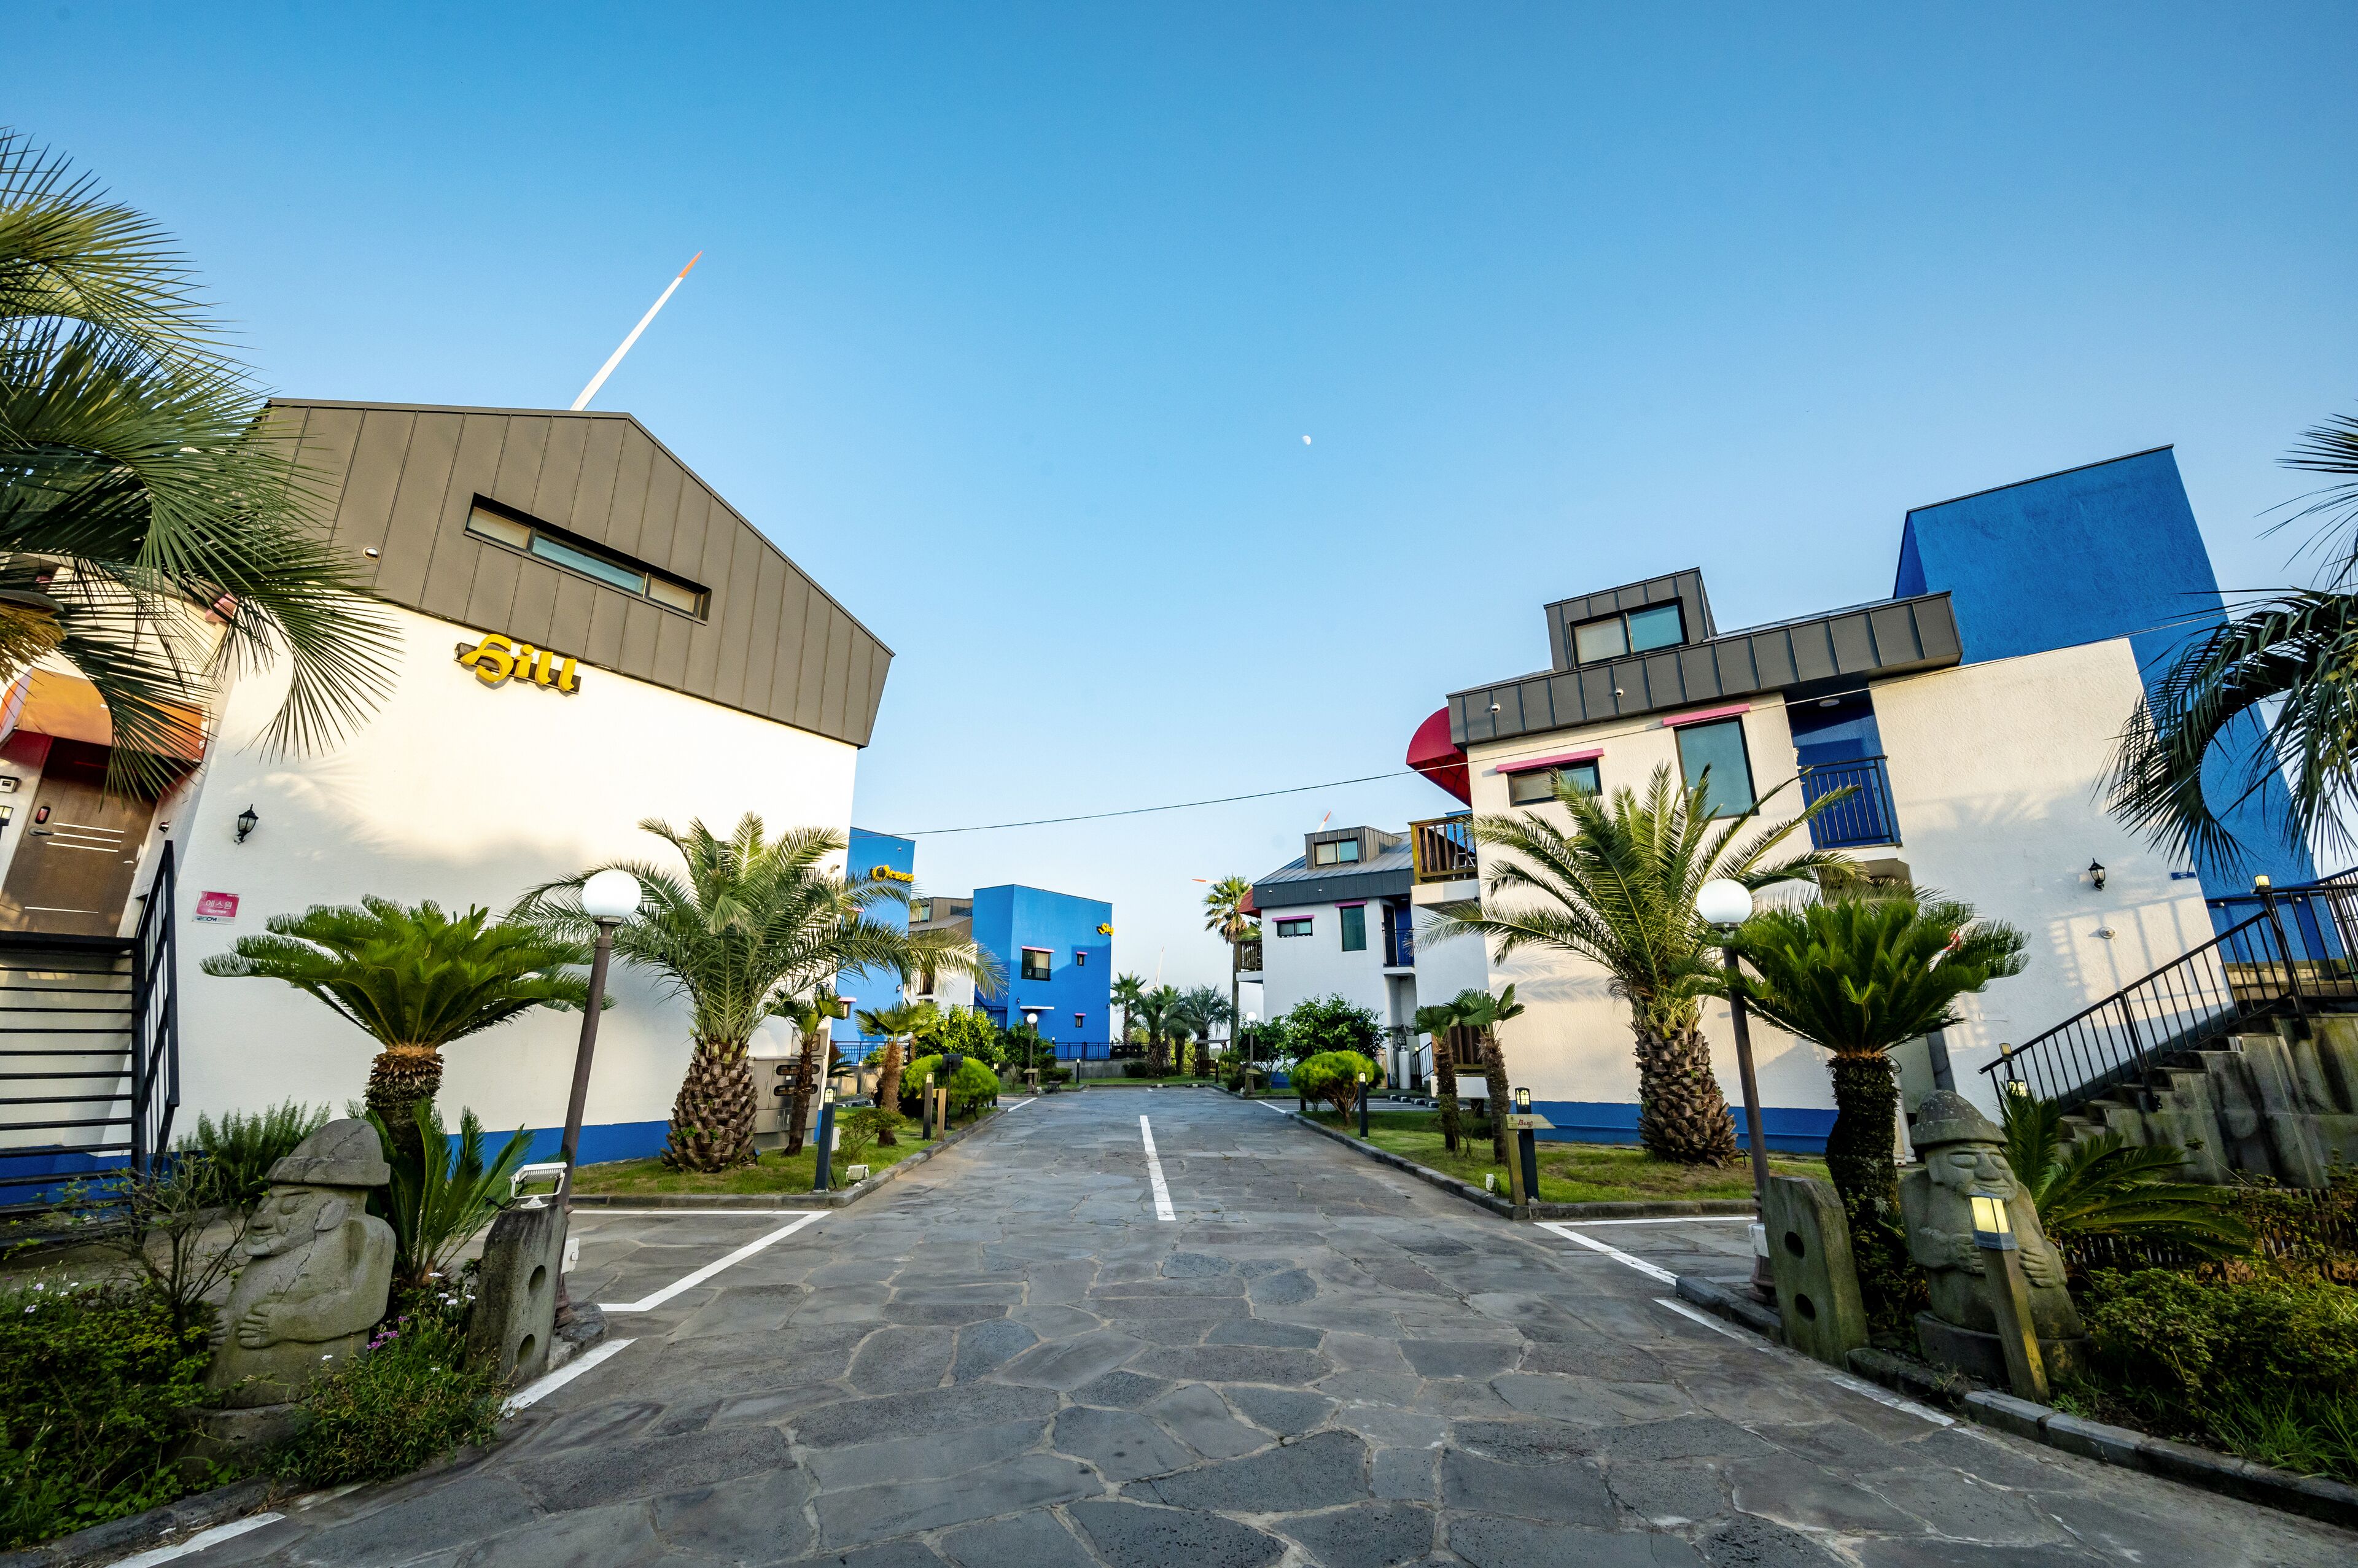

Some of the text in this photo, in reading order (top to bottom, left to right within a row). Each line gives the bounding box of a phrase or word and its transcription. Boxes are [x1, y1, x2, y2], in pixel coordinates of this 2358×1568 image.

[461, 634, 577, 692] Hill
[872, 864, 914, 882] Ocean
[1098, 923, 1115, 936] Sky
